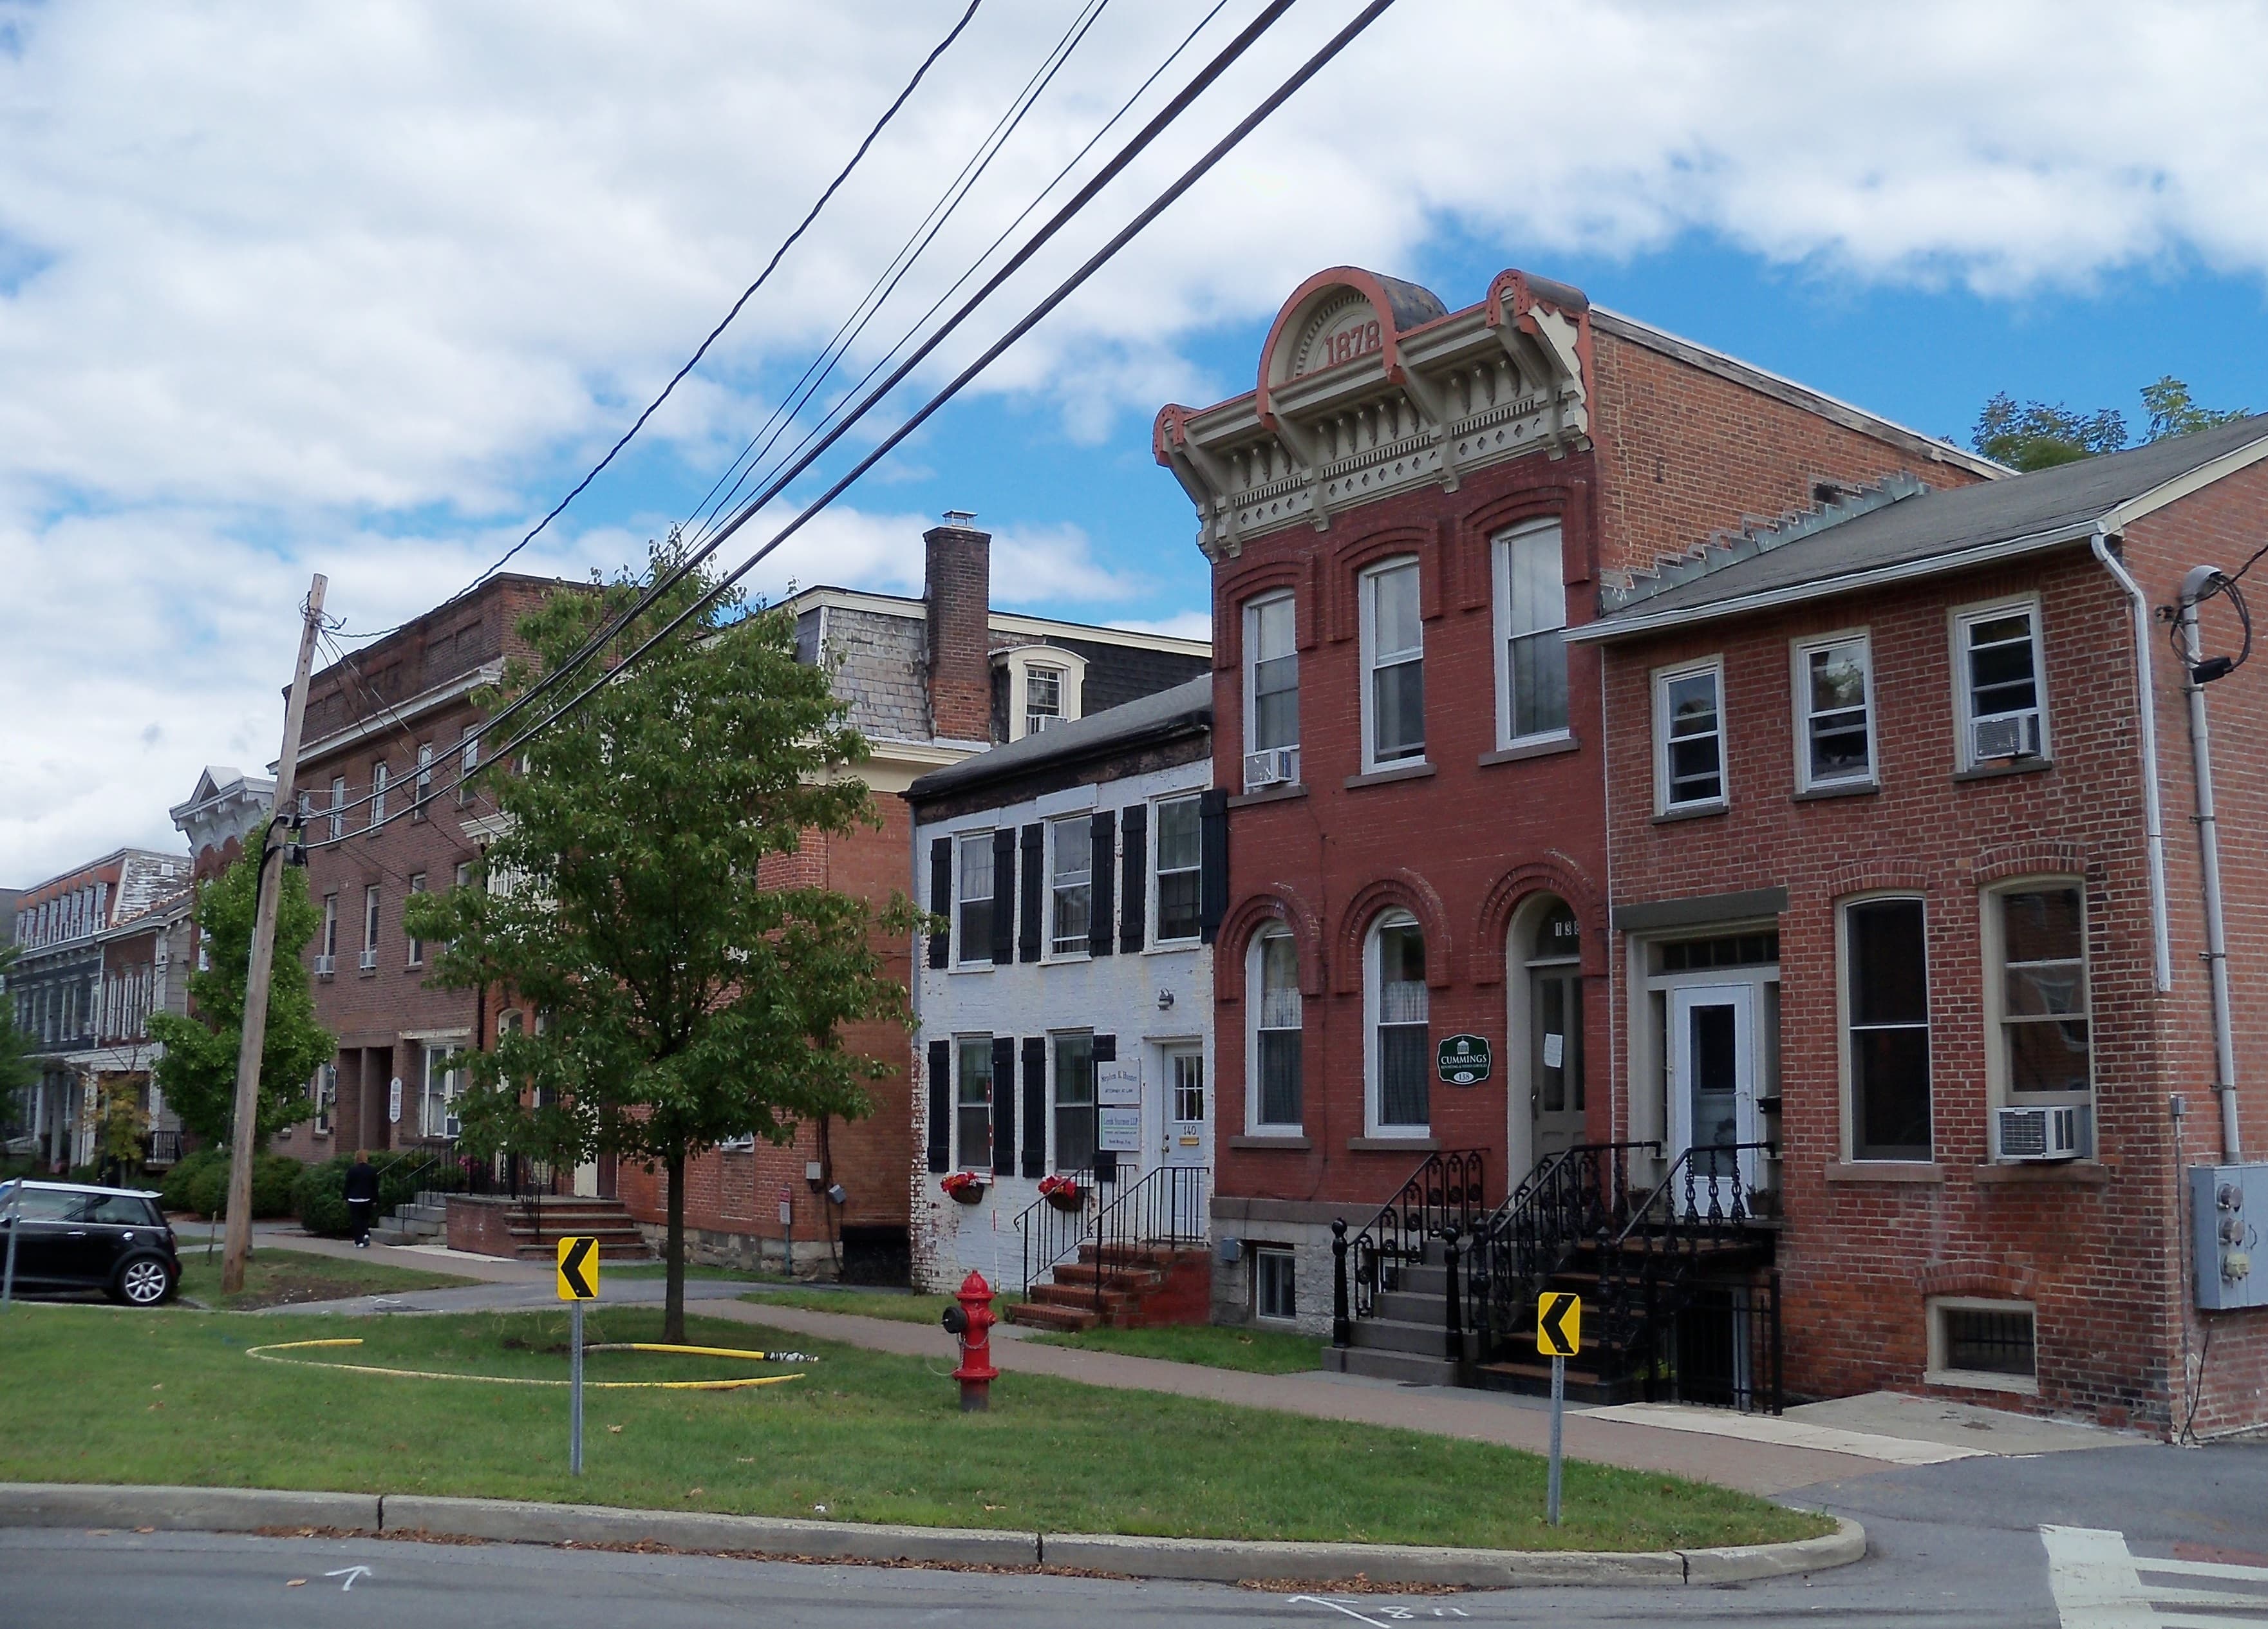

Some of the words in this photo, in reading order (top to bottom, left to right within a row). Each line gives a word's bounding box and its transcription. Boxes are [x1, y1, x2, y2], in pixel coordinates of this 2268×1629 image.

[1326, 320, 1380, 366] 1878
[1441, 1054, 1486, 1064] CUMMINGS
[1183, 1125, 1197, 1136] 140
